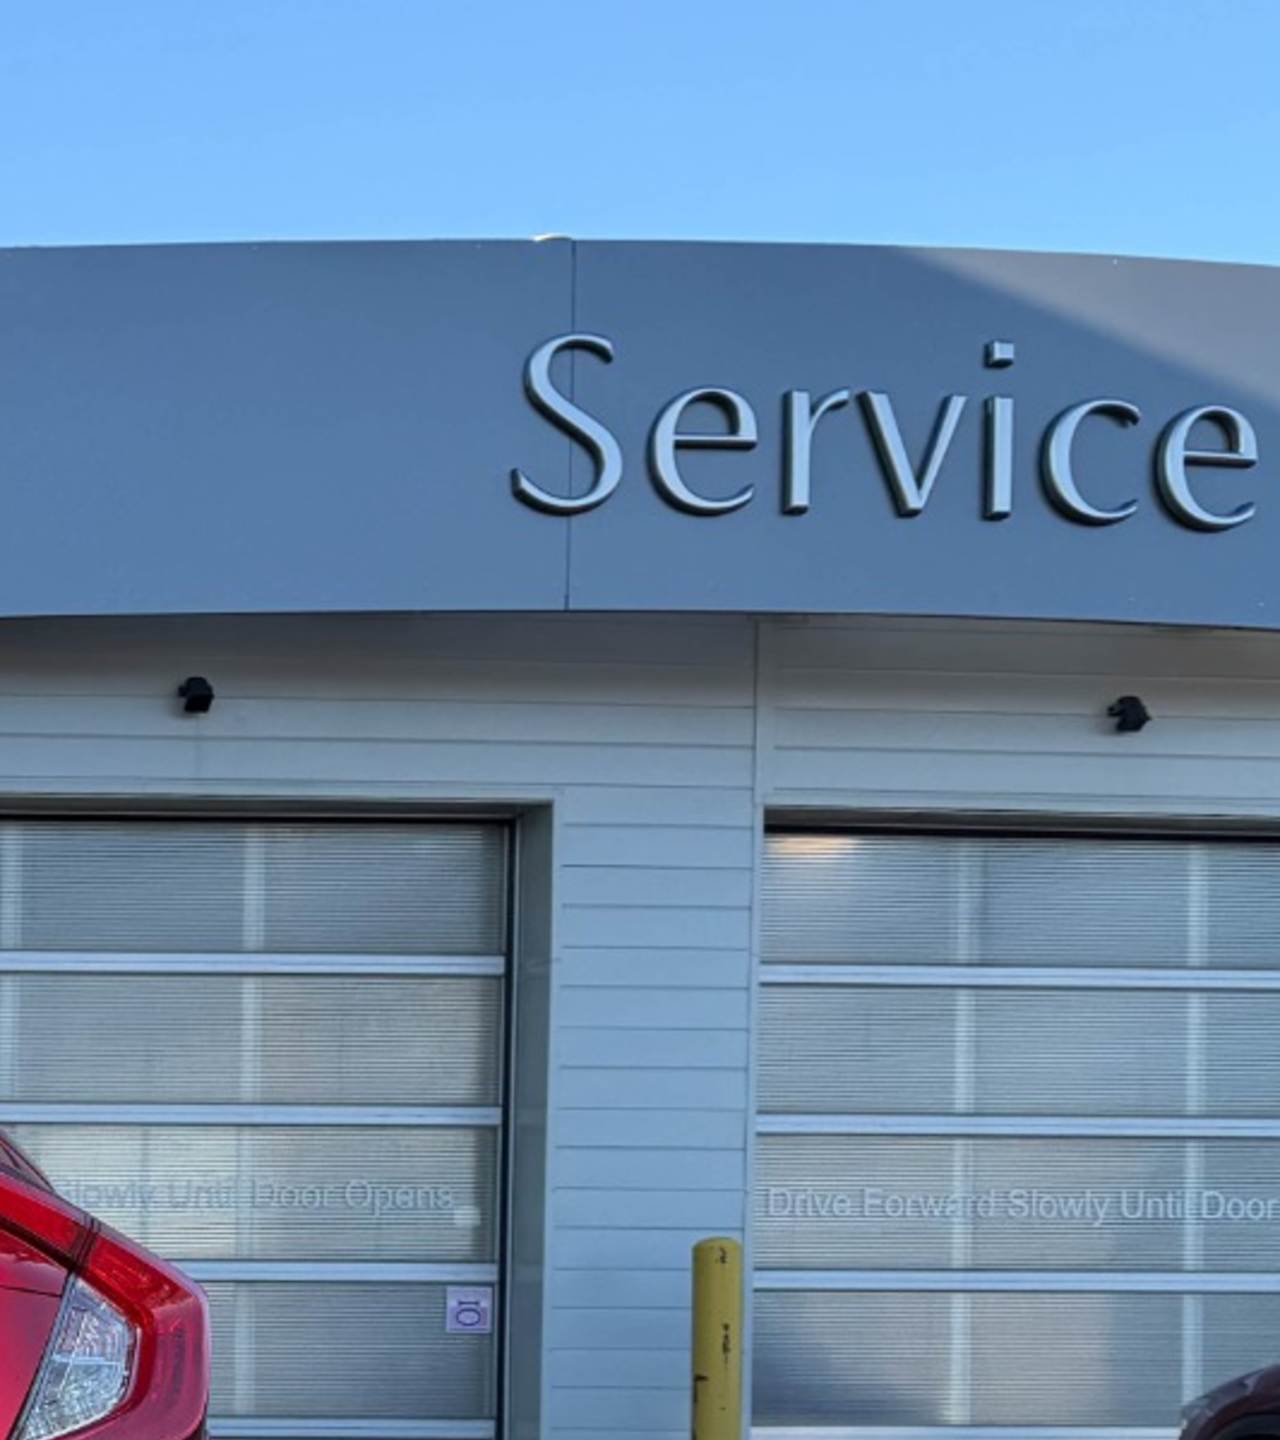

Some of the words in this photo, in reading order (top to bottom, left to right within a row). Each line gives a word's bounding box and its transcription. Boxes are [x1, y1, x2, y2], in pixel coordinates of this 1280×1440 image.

[510, 332, 1260, 533] Service
[251, 1180, 334, 1209] Door
[345, 1179, 454, 1217] Opens
[766, 1187, 852, 1218] Drive
[863, 1187, 996, 1218] Forward
[1007, 1188, 1110, 1228] Slowly
[1121, 1189, 1192, 1219] Until
[1200, 1189, 1280, 1220] Door
